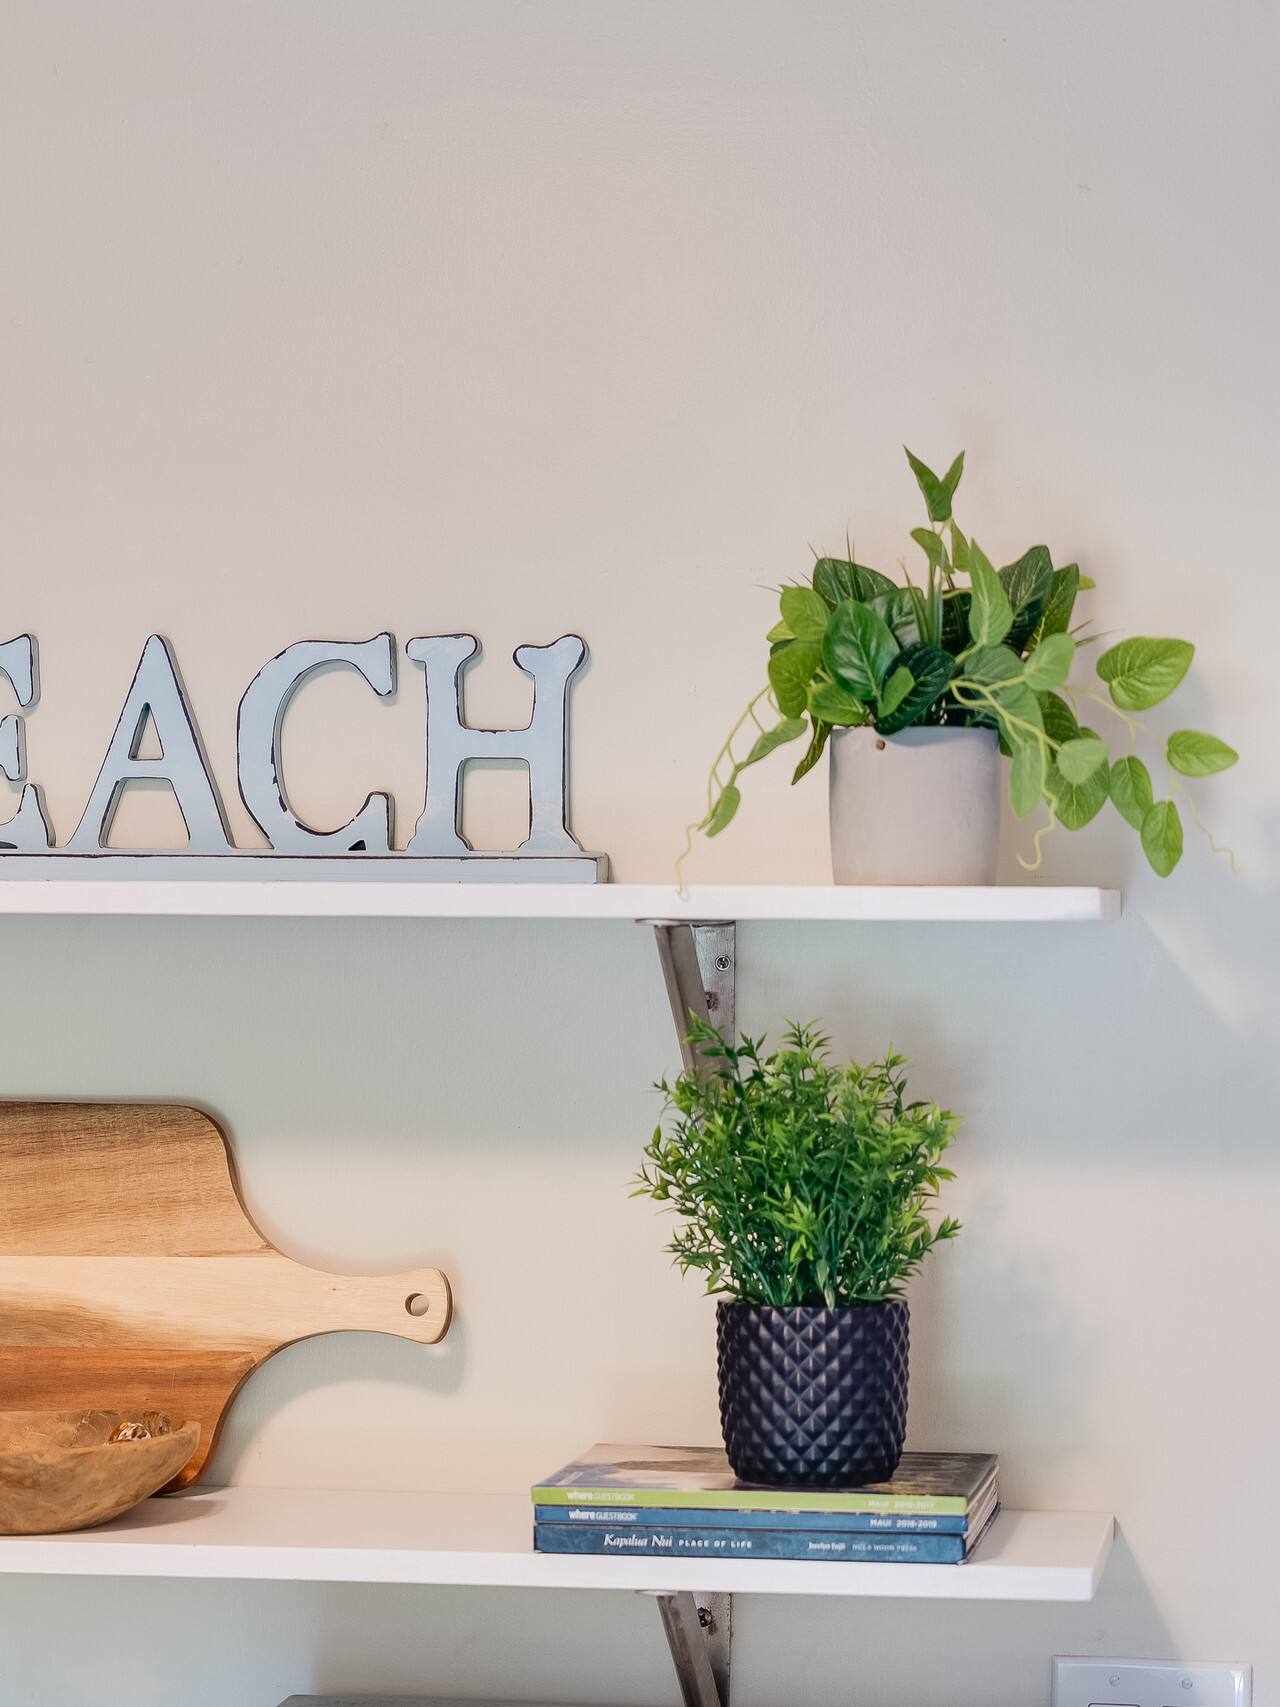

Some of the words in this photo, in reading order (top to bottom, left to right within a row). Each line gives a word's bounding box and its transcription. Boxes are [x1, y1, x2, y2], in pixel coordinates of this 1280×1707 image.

[869, 1519, 892, 1528] MAUI
[604, 1533, 648, 1548] Kapalua
[651, 1535, 673, 1547] Nui
[678, 1539, 710, 1548] PLACE
[714, 1540, 726, 1548] OF
[731, 1541, 753, 1549] LIFE
